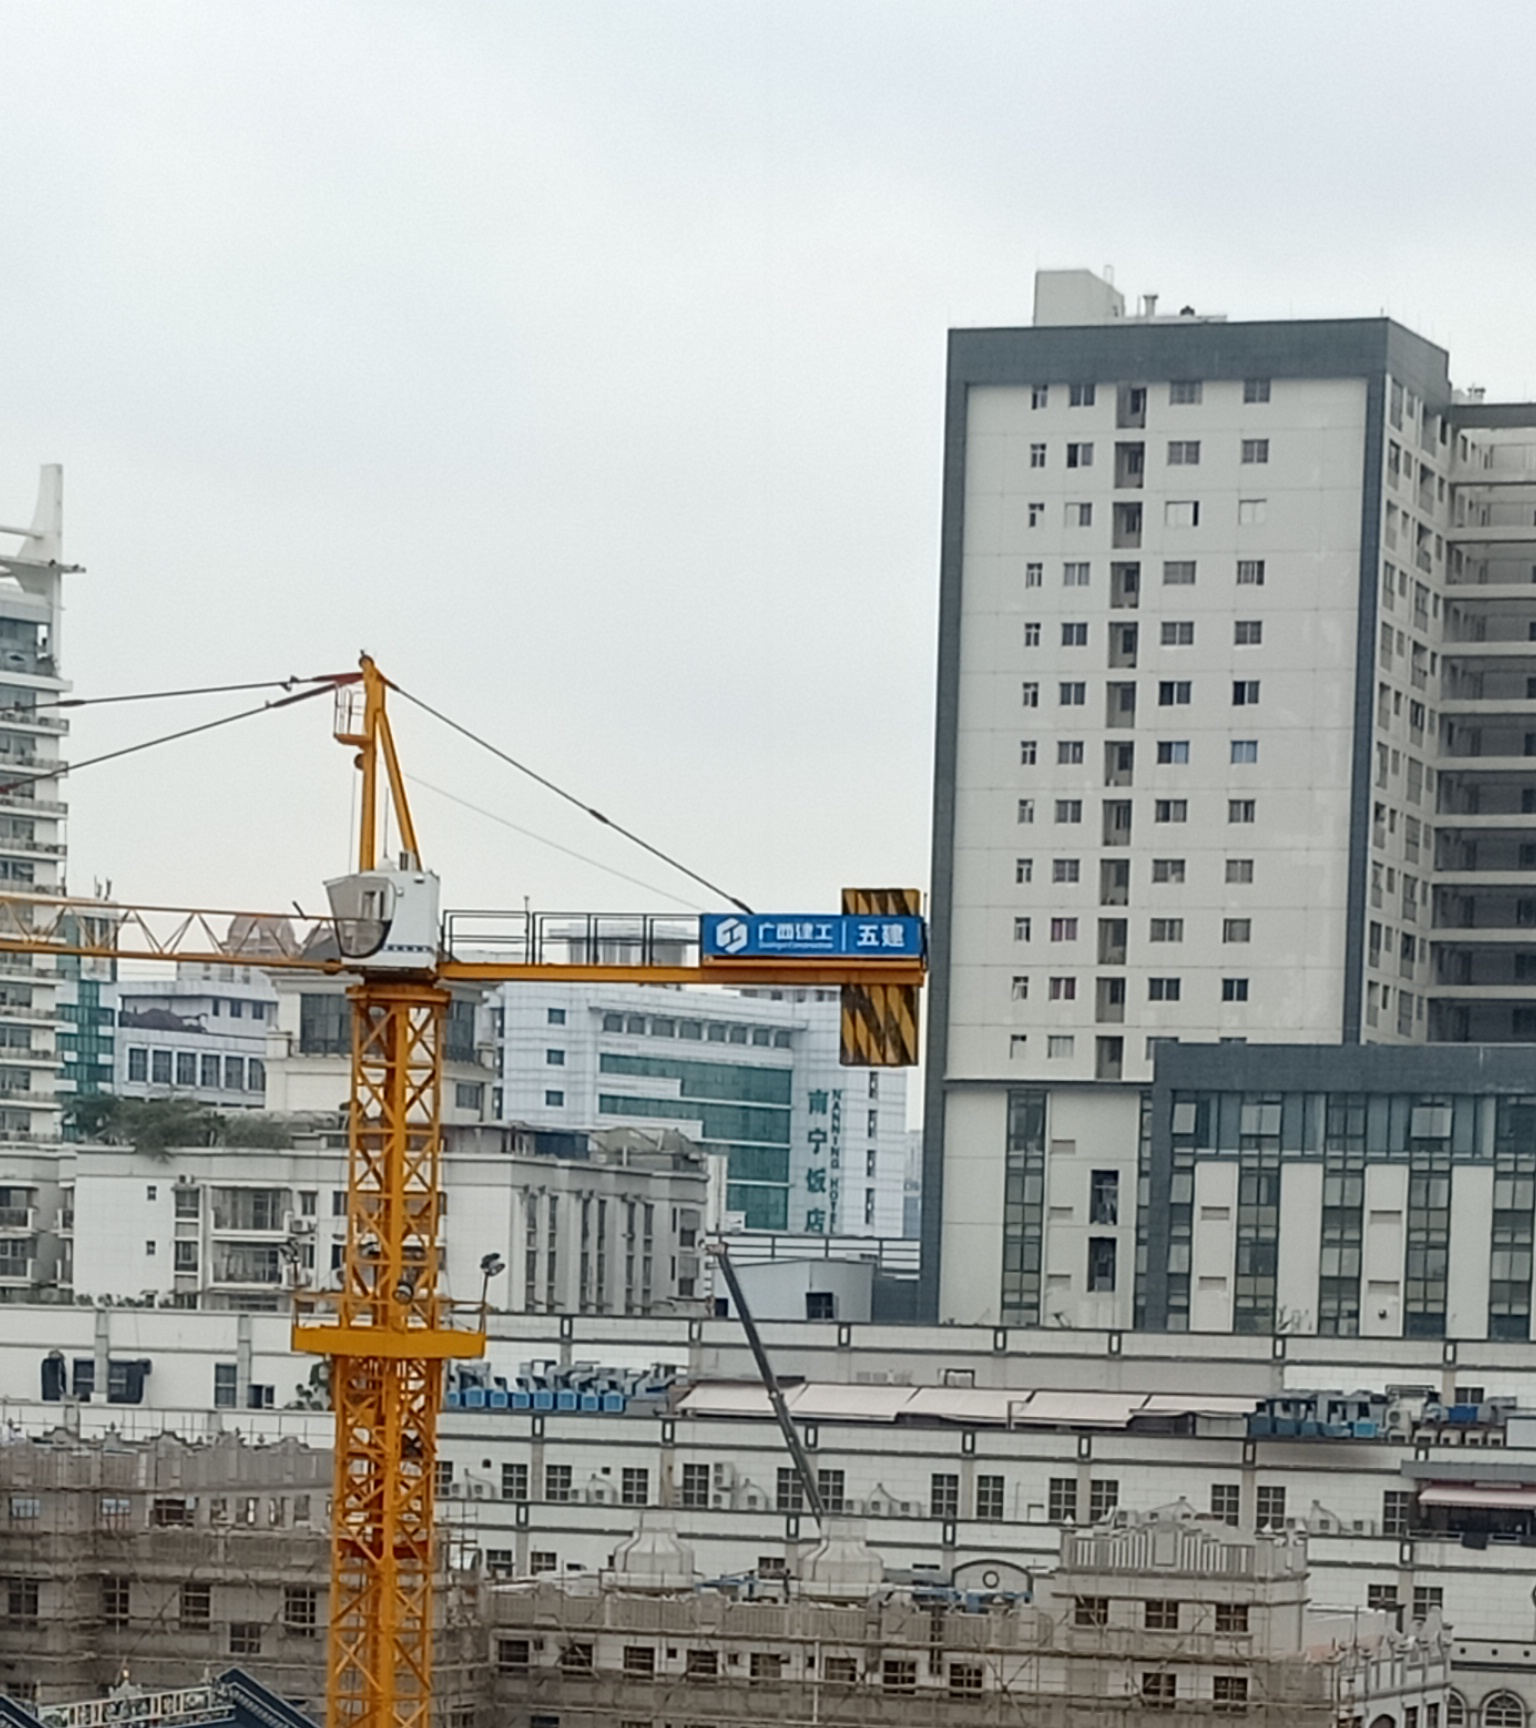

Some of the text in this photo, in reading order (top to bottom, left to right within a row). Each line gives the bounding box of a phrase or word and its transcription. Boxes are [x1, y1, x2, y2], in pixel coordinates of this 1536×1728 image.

[759, 922, 905, 948] 广西建工 五建
[805, 1089, 828, 1234] 南宁饭店
[829, 1089, 842, 1234] NANNING HOTEL
